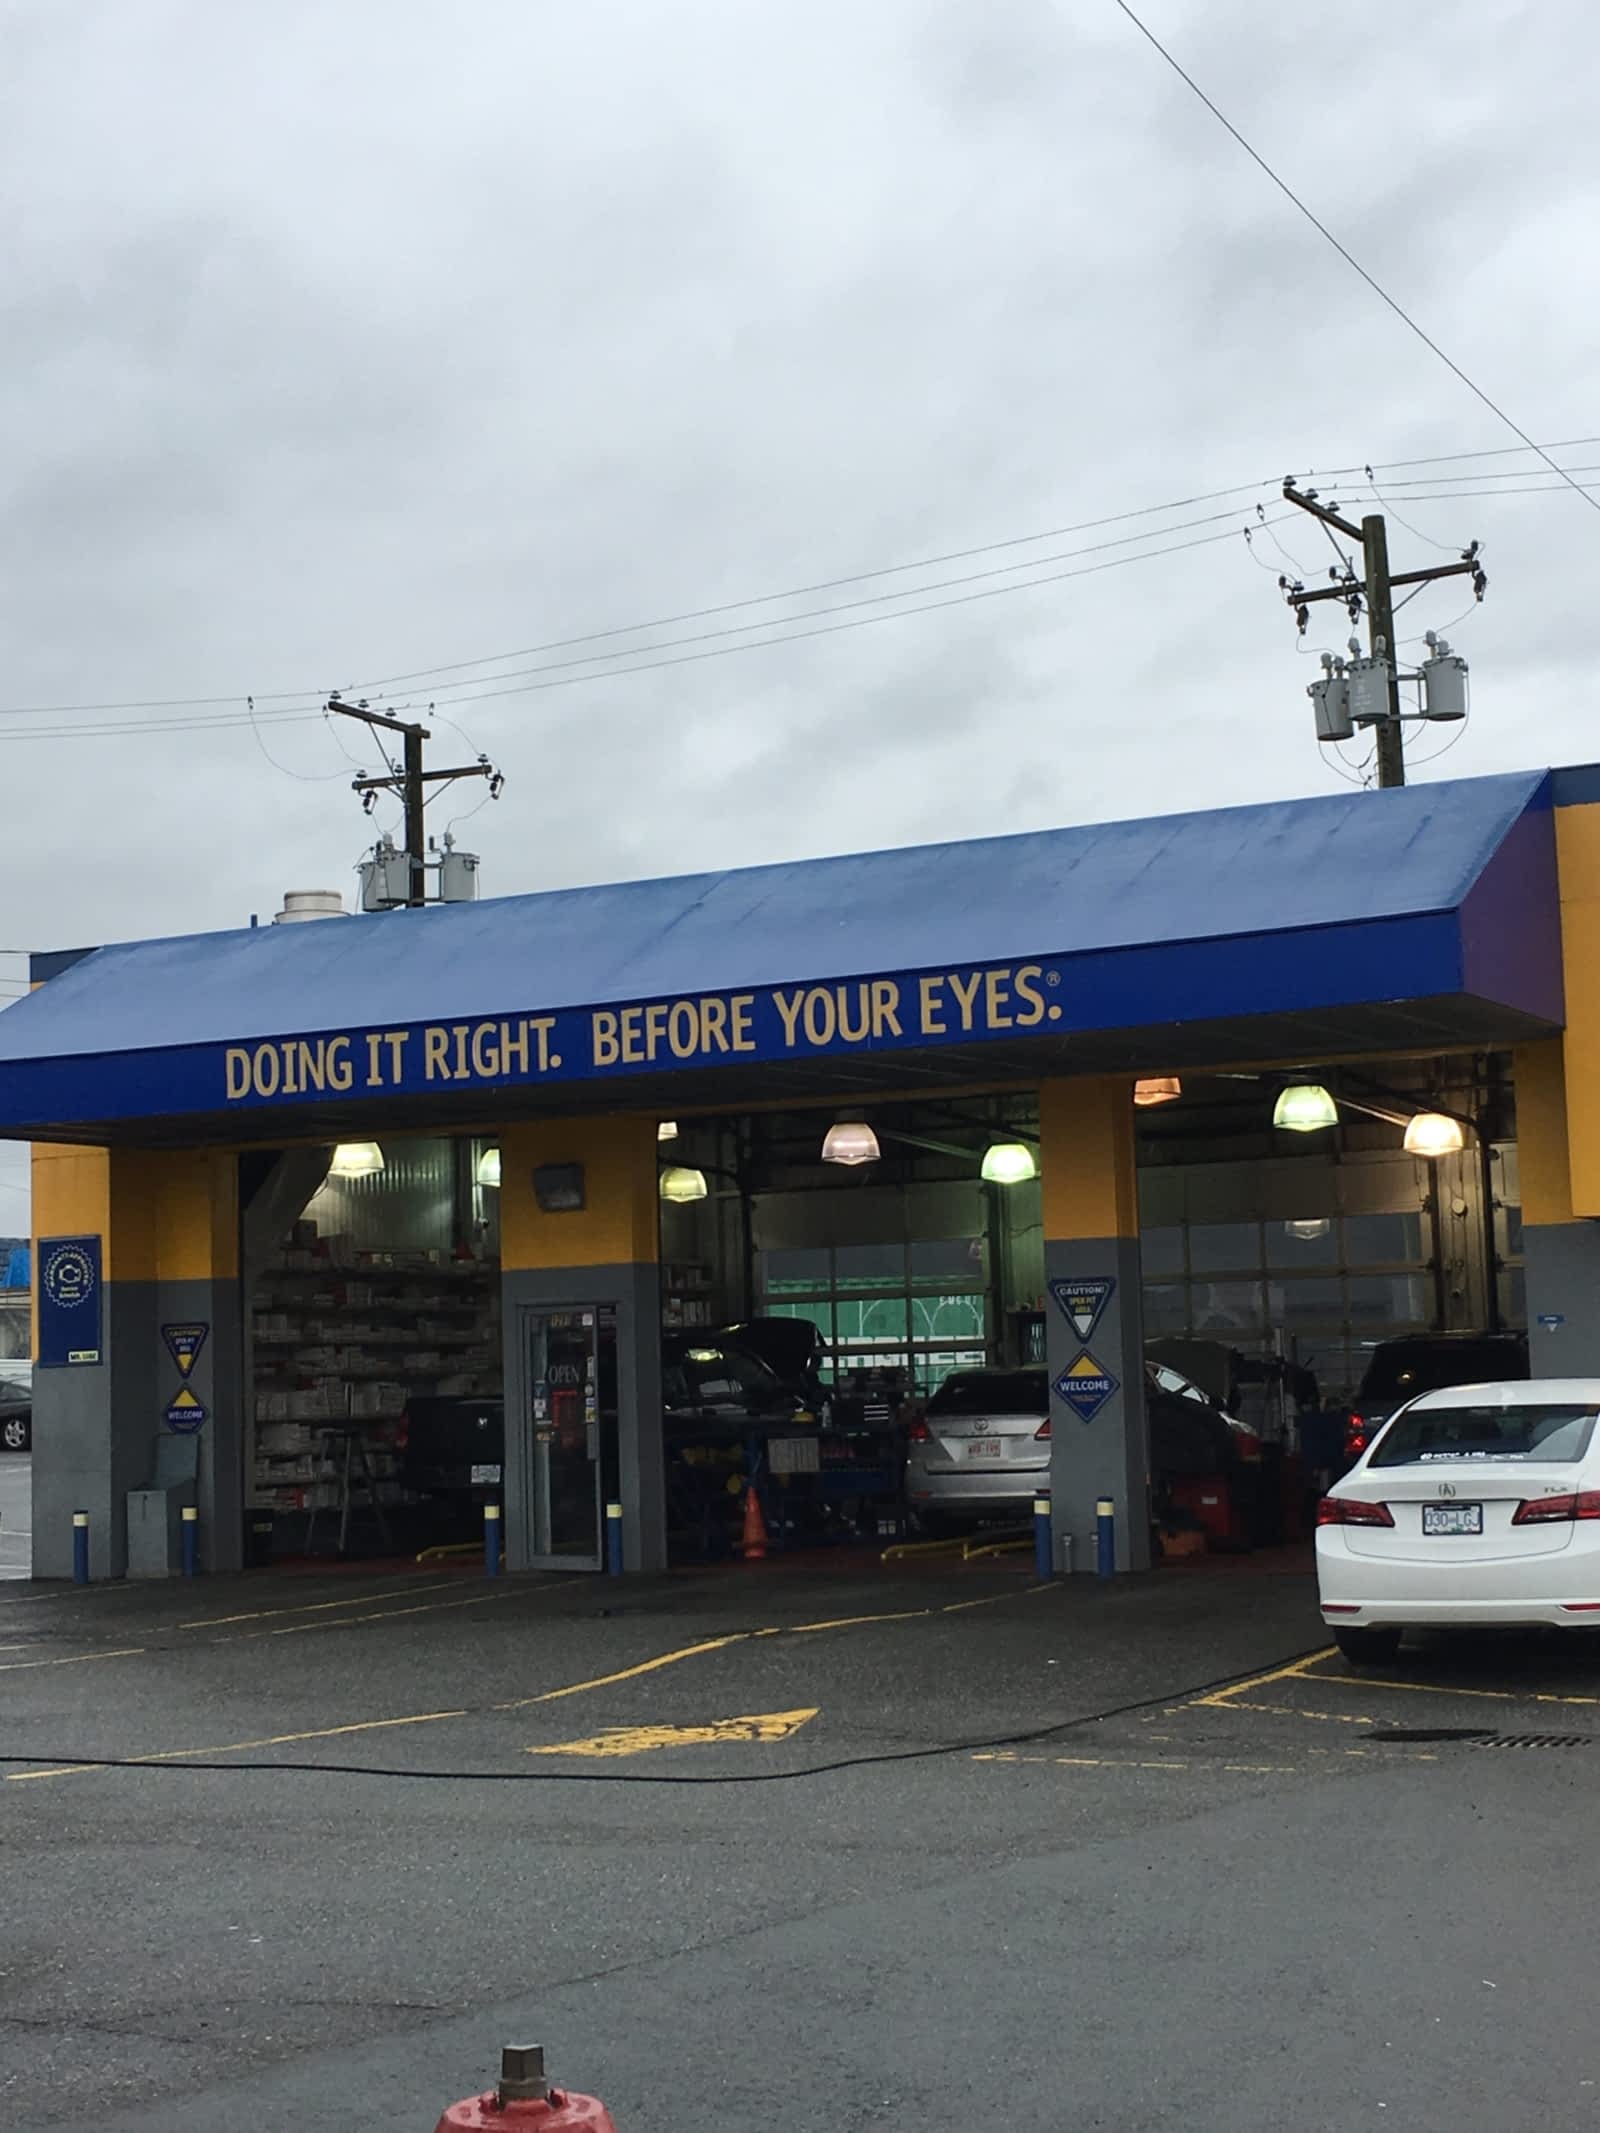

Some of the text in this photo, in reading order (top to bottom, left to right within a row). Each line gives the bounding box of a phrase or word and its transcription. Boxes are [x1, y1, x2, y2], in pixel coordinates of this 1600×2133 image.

[225, 1036, 353, 1099] DOING
[366, 1031, 410, 1087] IT
[424, 1017, 562, 1080] RIGHT.
[592, 994, 757, 1066] BEFORE
[772, 979, 903, 1047] YOUR
[547, 1365, 580, 1385] OPEN
[1059, 1380, 1110, 1391] WELCOME
